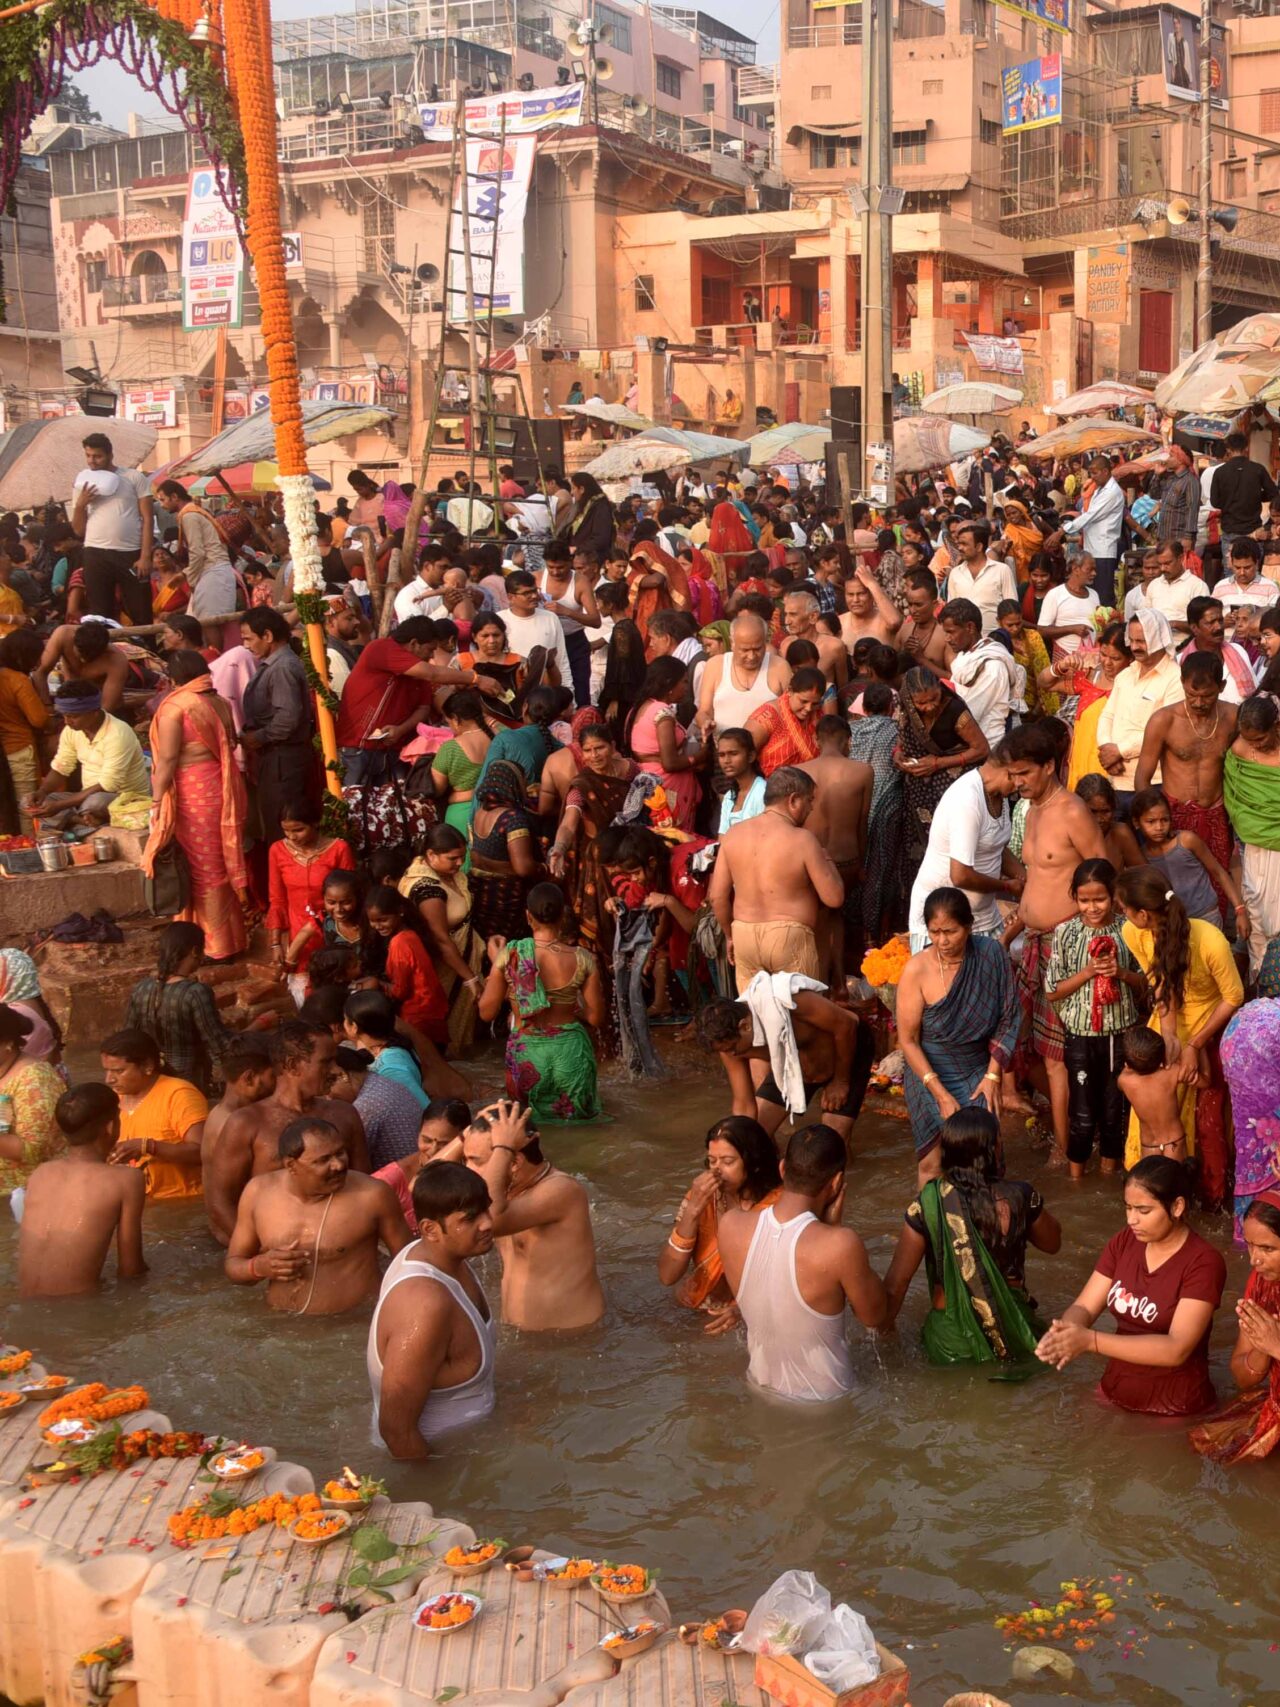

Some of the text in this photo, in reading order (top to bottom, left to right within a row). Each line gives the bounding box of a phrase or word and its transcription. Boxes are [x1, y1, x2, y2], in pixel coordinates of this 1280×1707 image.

[210, 240, 233, 262] LIC
[1088, 262, 1122, 278] PANDEY
[1088, 280, 1121, 296] SAREE
[1088, 299, 1120, 313] FACTORY
